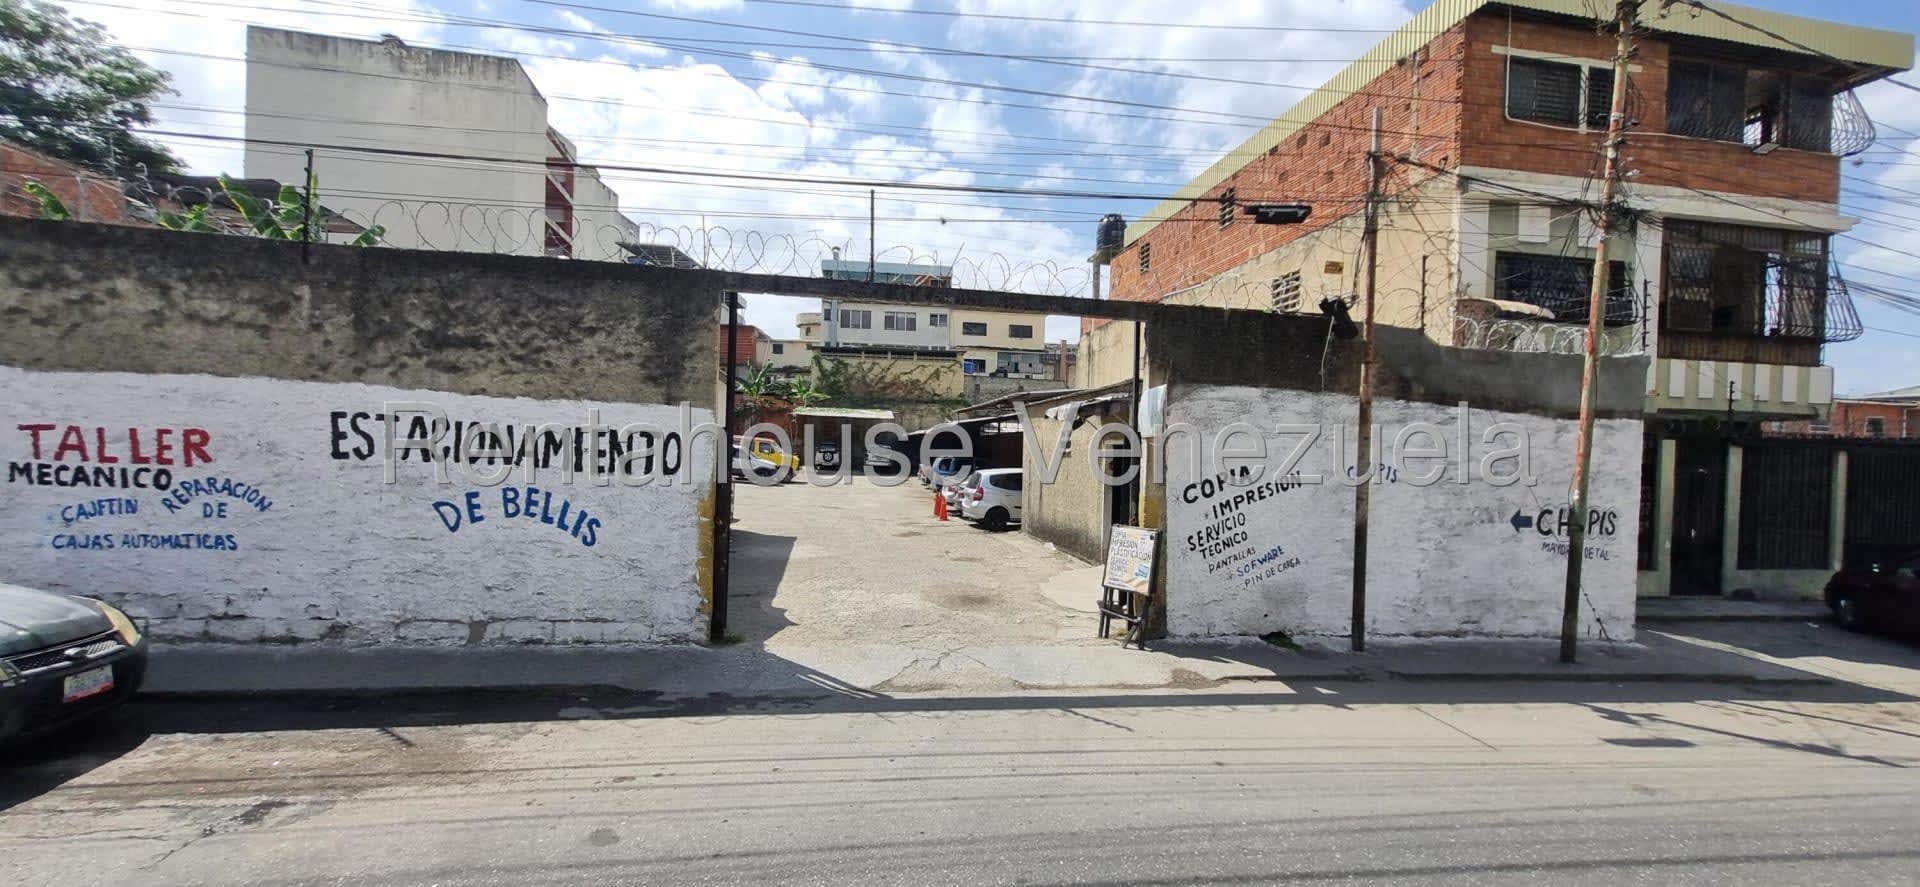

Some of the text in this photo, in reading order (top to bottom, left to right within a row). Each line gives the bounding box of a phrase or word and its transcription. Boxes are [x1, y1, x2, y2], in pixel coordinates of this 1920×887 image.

[17, 423, 213, 467] TALLER
[330, 411, 681, 475] ESTACIONAMIENTO
[8, 462, 173, 490] MECANICO
[1183, 466, 1252, 504] COPIA
[161, 476, 273, 514] REPARACION
[203, 502, 228, 518] DE
[1212, 470, 1303, 519] IMPRESION
[433, 487, 601, 547] DE BELLIS
[1187, 512, 1246, 551] SERVICIO
[1536, 508, 1617, 536] CHPIS
[52, 533, 239, 551] CAJAS AUTOMATICAS
[1208, 546, 1257, 574] PANTALLAS
[1236, 545, 1285, 577] SOFWARE
[1244, 573, 1264, 588] PIN
